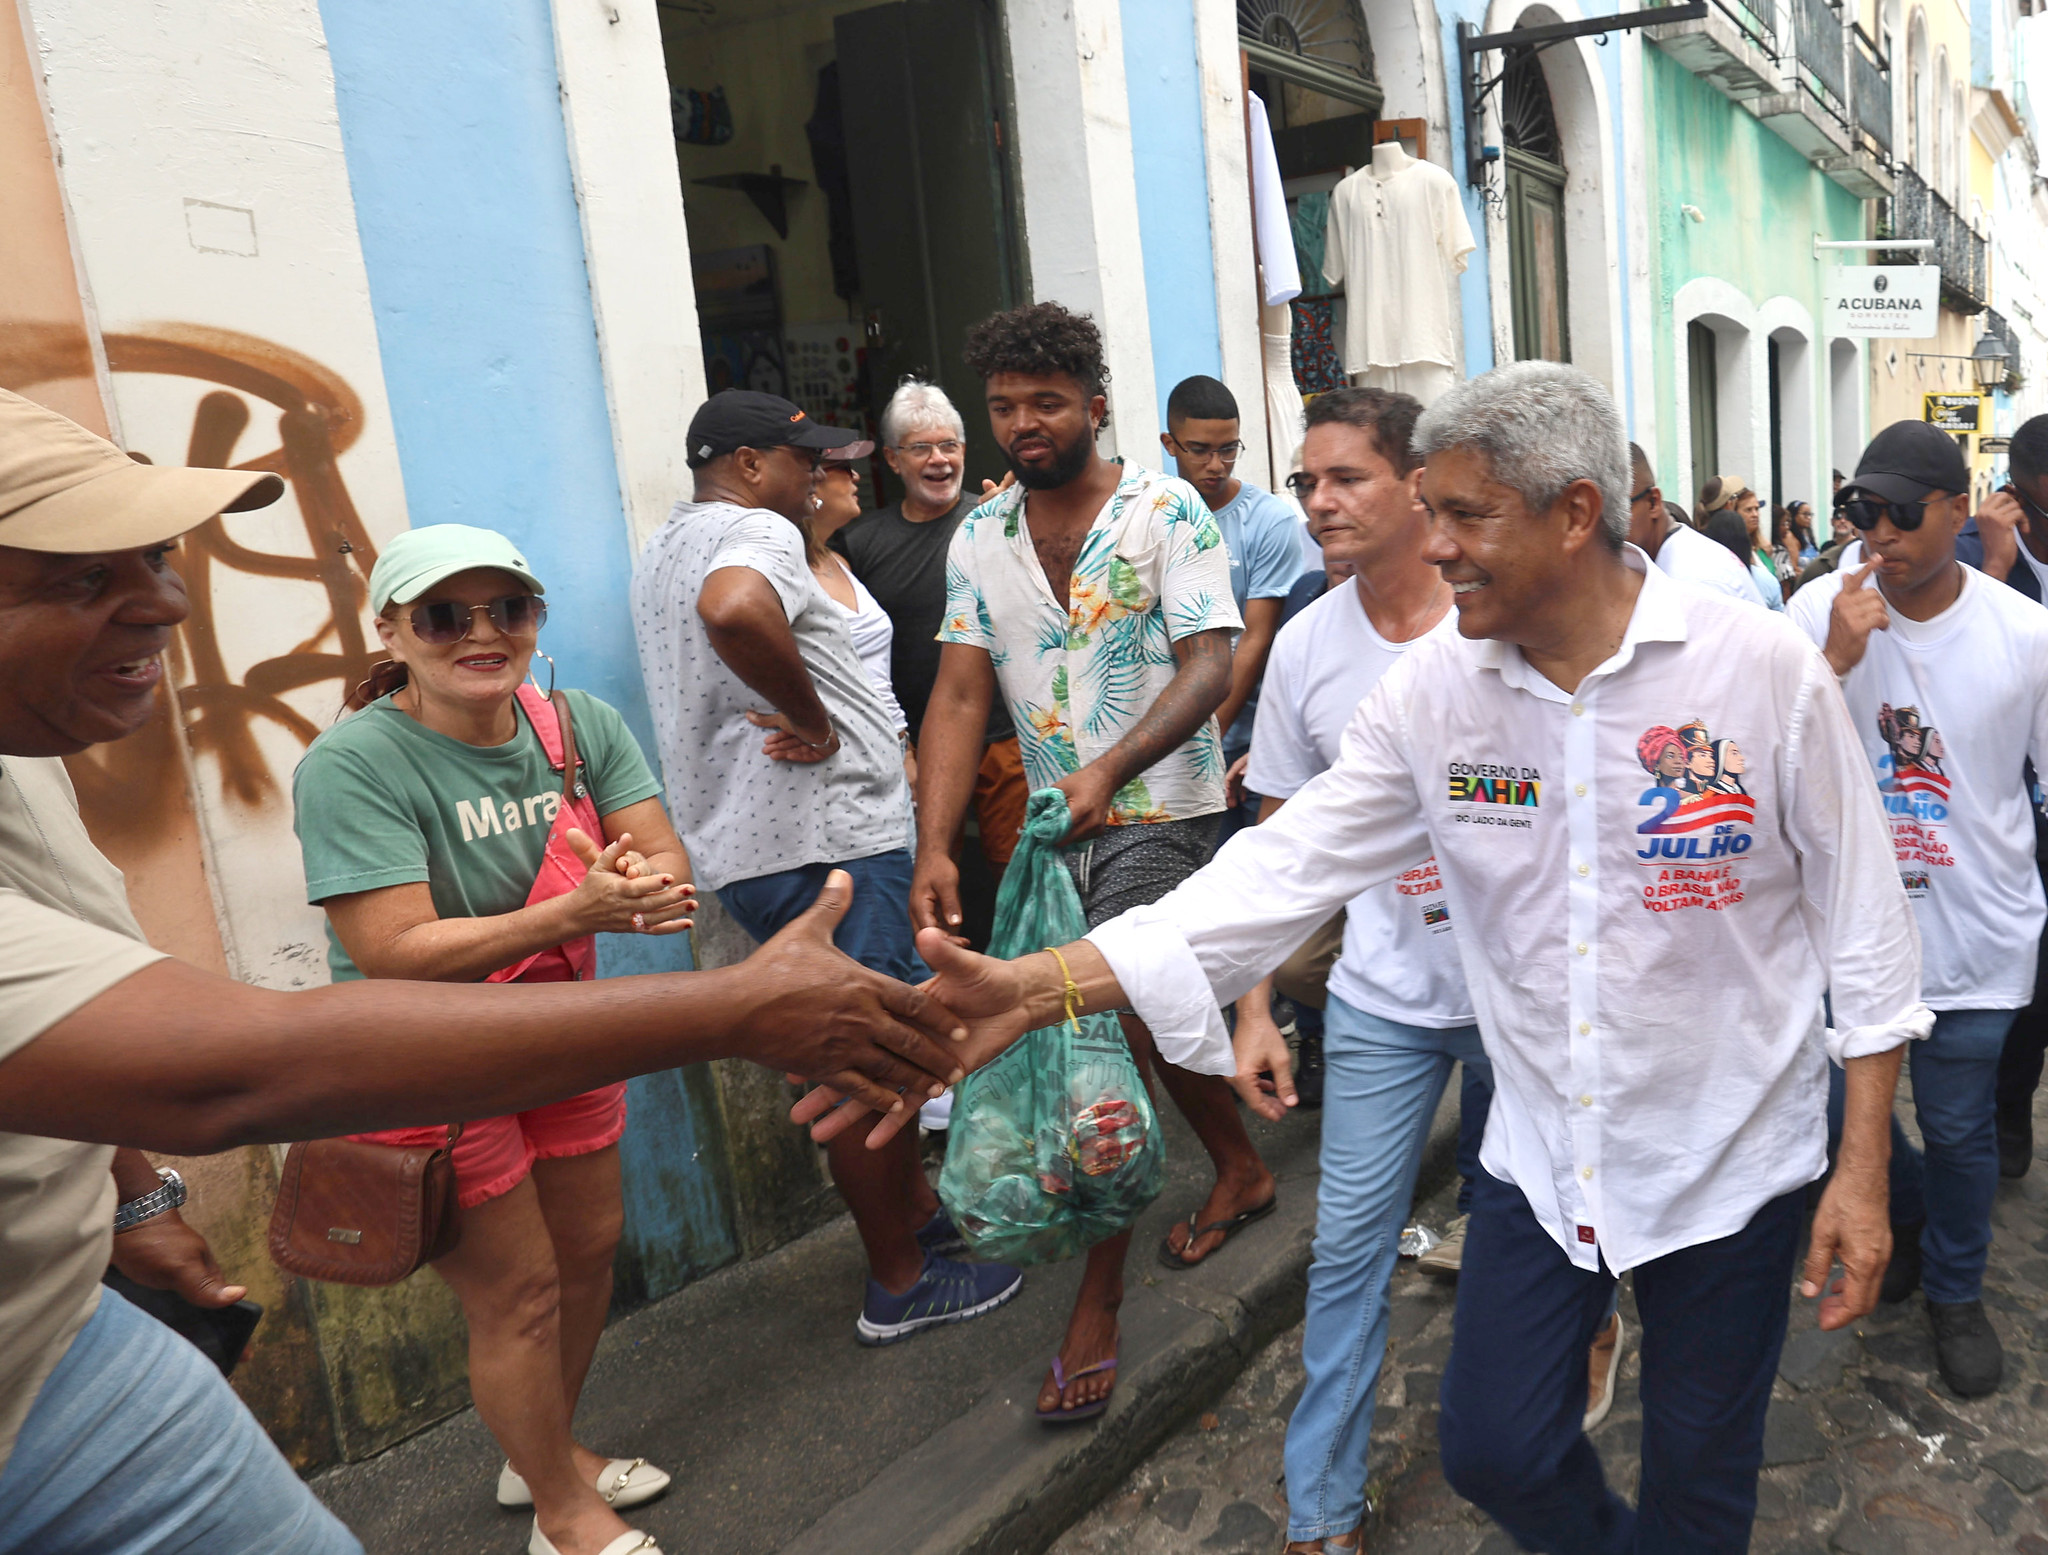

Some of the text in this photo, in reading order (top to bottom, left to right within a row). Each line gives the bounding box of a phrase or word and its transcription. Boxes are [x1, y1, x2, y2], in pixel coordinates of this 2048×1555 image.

[1449, 762, 1541, 780] GOVERNO DA
[1448, 776, 1541, 807] BAHIA
[1914, 792, 1929, 801] DE
[455, 790, 562, 842] Mara
[1637, 786, 1681, 834] 2
[1883, 795, 1948, 821] ULHO
[1456, 814, 1470, 823] DO
[1509, 818, 1533, 829] GENTE
[1714, 824, 1735, 835] DE
[1927, 830, 1937, 841] E
[1637, 833, 1752, 859] JULHO
[1658, 865, 1733, 883] A BAHIA E
[1643, 878, 1742, 897] O BRASIL NÃO
[1642, 891, 1745, 913] VOLTAM ATRÁS
